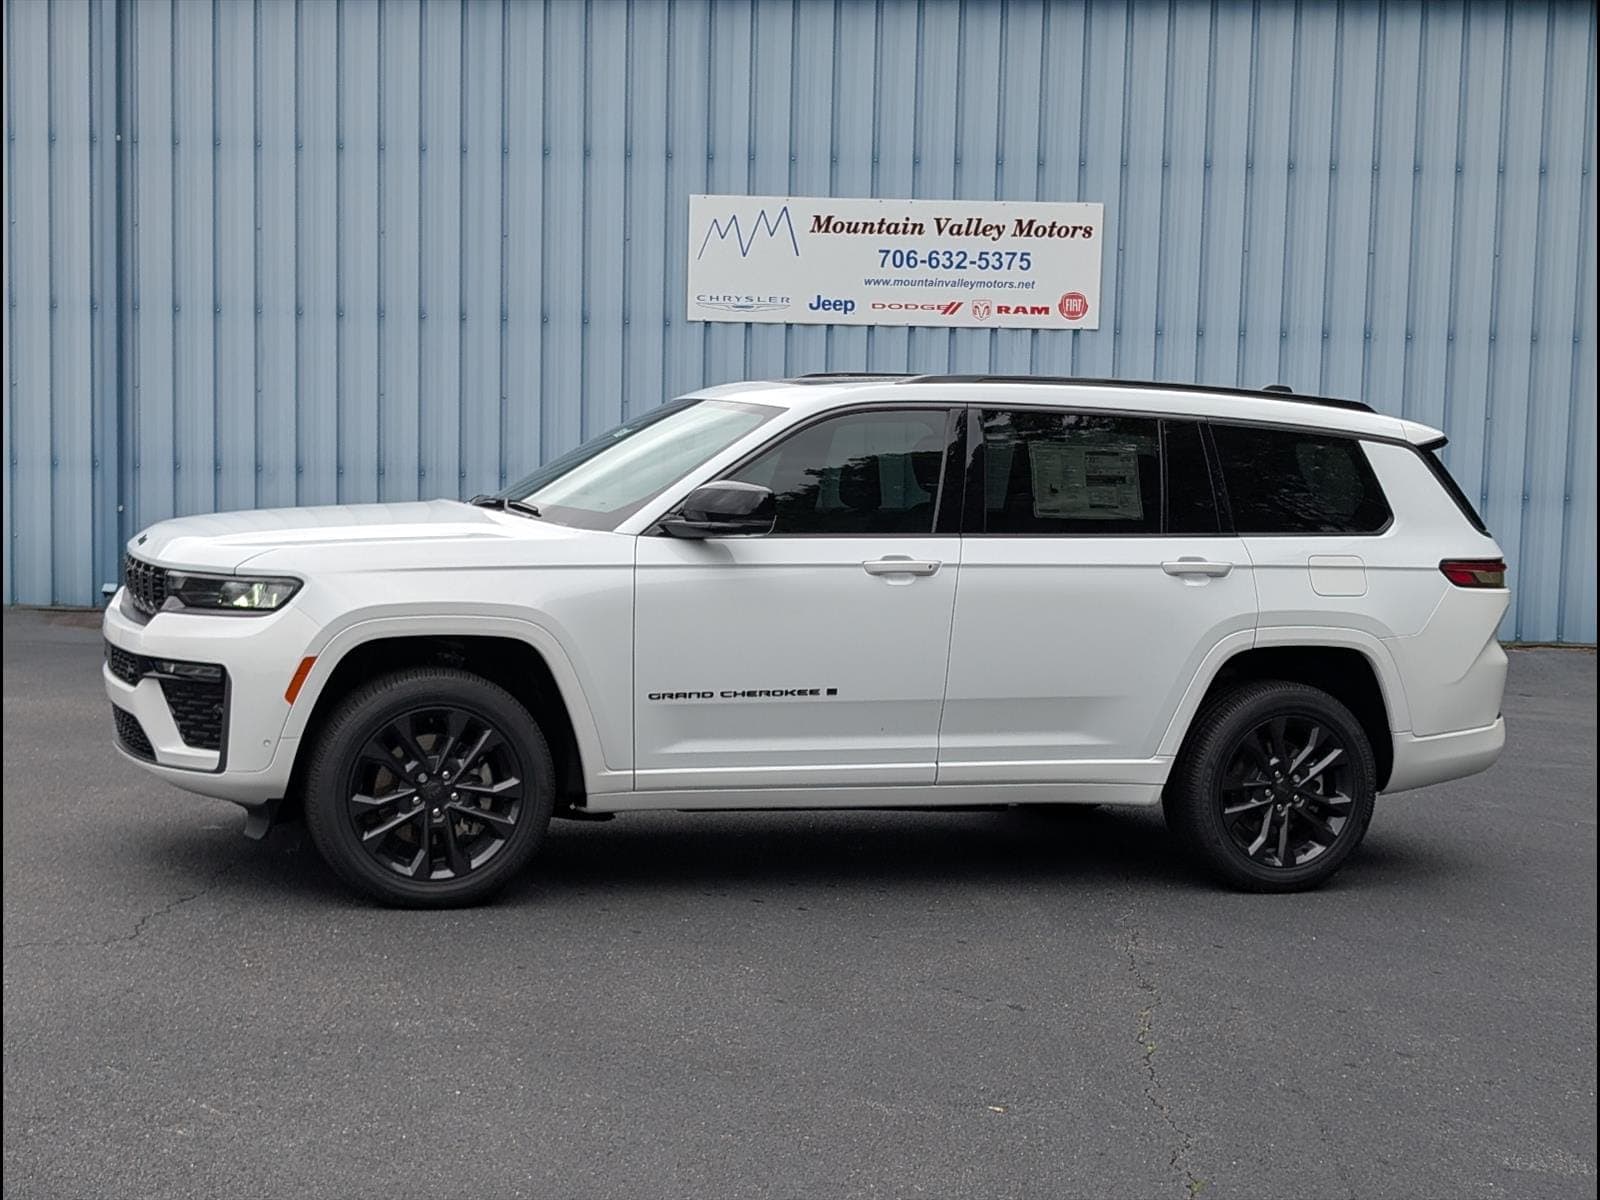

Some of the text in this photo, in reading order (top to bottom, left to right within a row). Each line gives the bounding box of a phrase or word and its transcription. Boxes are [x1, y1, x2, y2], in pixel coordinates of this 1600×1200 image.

[810, 215, 1093, 241] Mountain Valley Motors
[878, 249, 1031, 271] 706-632-5375
[864, 277, 1036, 290] www.mountainvalleymotors.net
[696, 294, 791, 304] CHRYSLER
[809, 295, 855, 314] Jeep
[871, 303, 947, 312] DODGE
[997, 305, 1050, 315] RAM
[648, 692, 714, 700] GRAND
[720, 688, 820, 698] CHEROKEE
